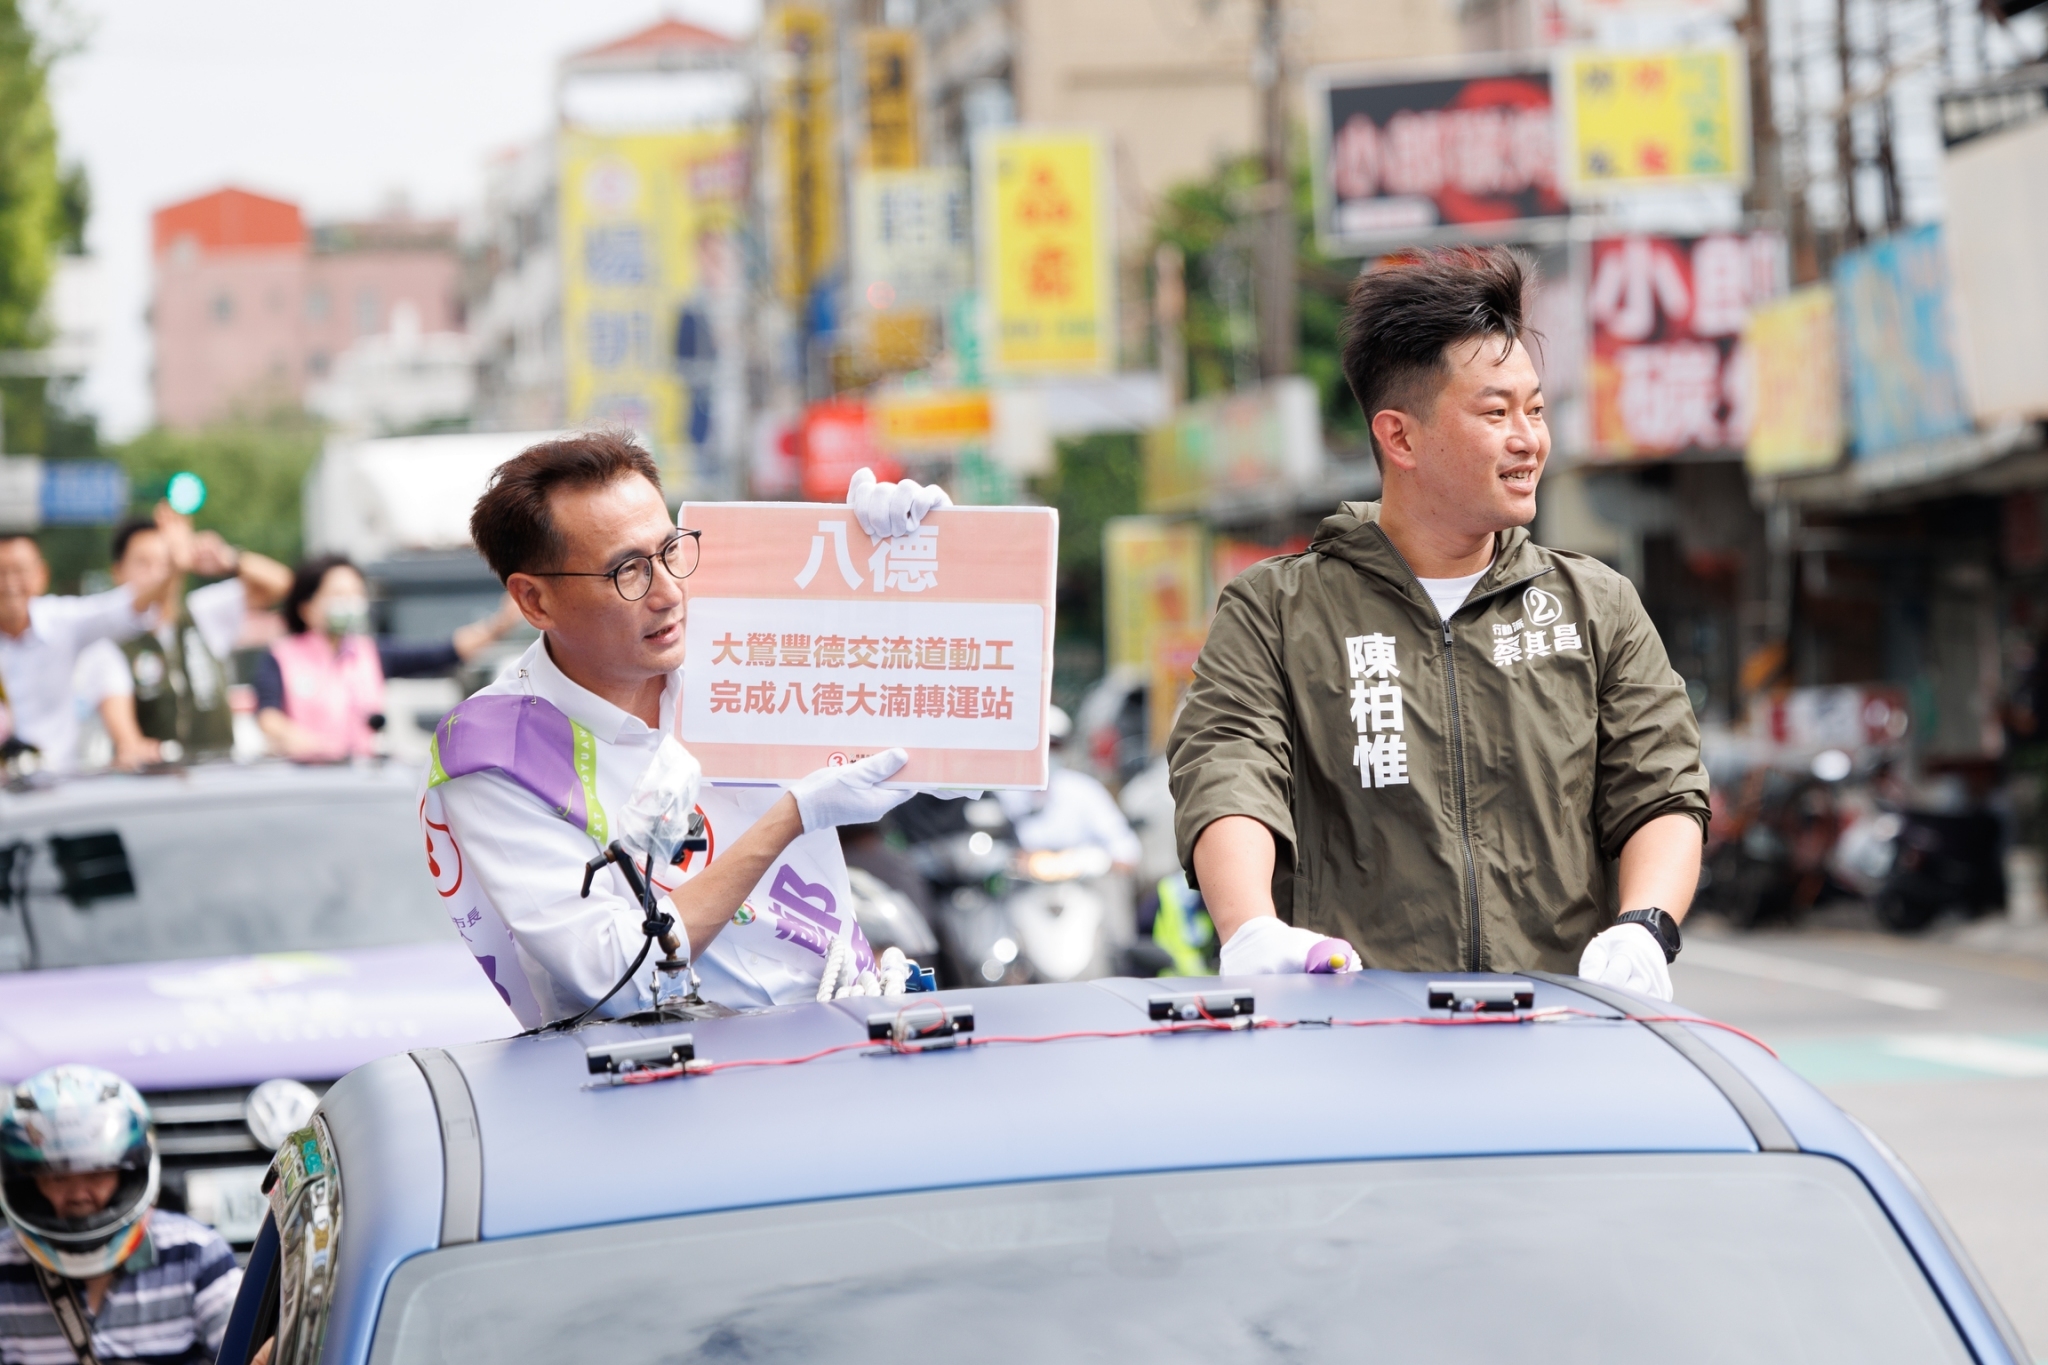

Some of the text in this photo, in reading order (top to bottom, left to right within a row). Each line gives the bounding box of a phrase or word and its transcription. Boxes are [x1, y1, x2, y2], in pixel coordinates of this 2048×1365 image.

[794, 520, 939, 593] 八德
[711, 632, 1014, 671] 大鶯豐德交流道動工
[1492, 622, 1582, 667] 蔡其昌
[710, 680, 1014, 720] 完成八德大湳轉運站
[1345, 632, 1409, 788] 陳柏惟
